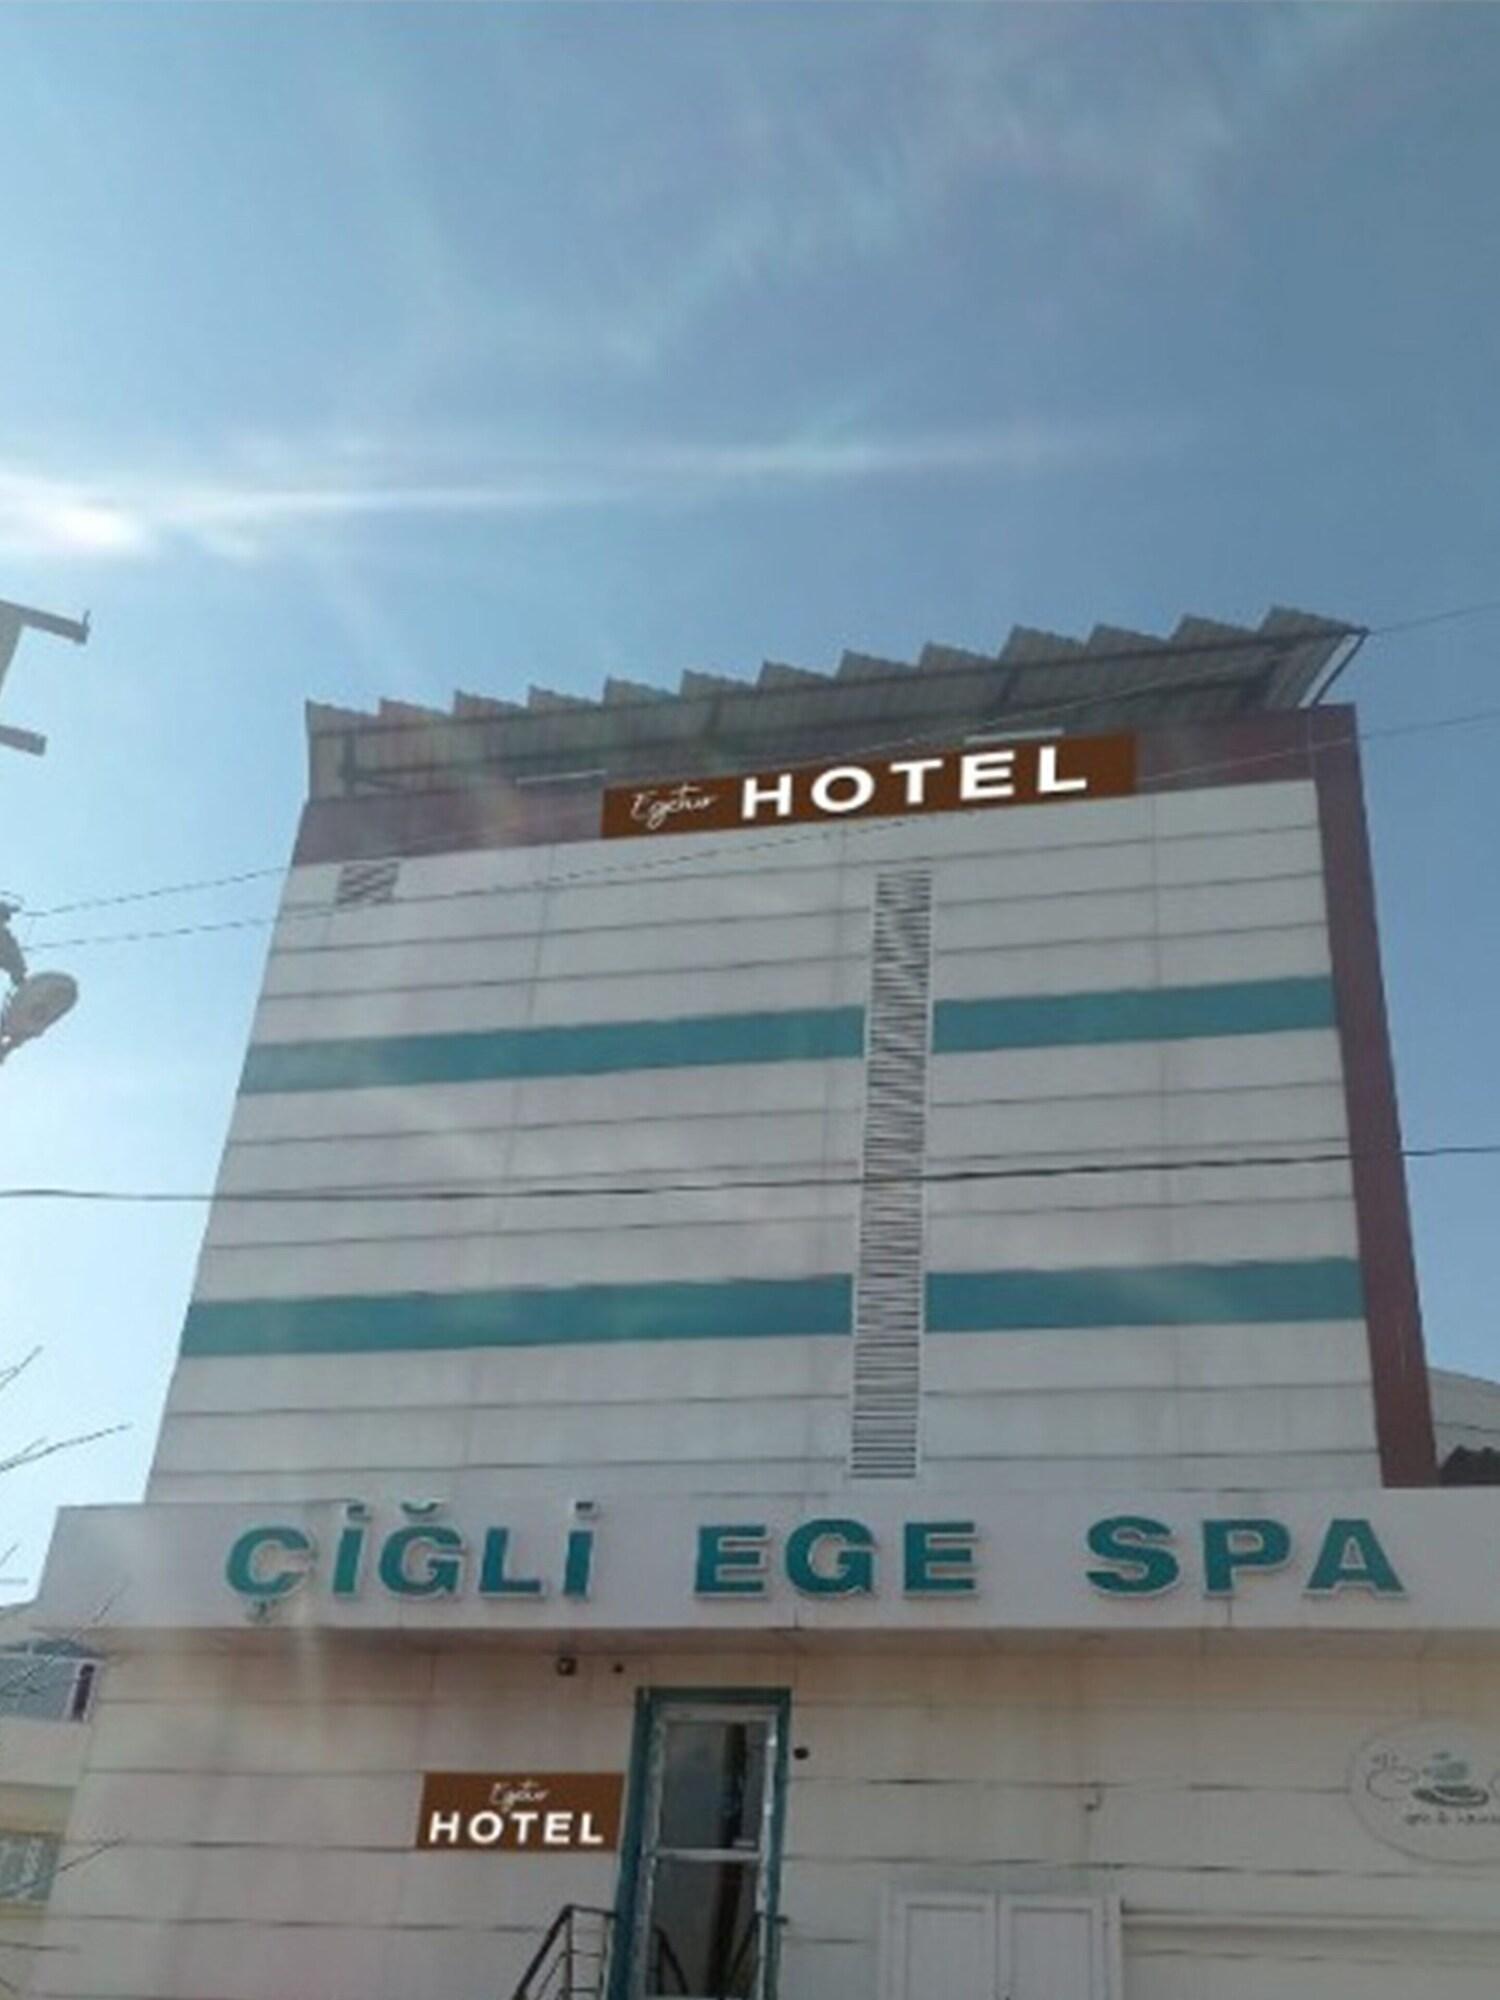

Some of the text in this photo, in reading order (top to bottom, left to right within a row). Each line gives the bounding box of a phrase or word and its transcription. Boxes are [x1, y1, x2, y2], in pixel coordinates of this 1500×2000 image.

[742, 746, 1087, 820] HOTEL
[225, 1500, 1405, 1622] ÇİĞLİ EGE SPA
[429, 1811, 604, 1844] HOTEL
